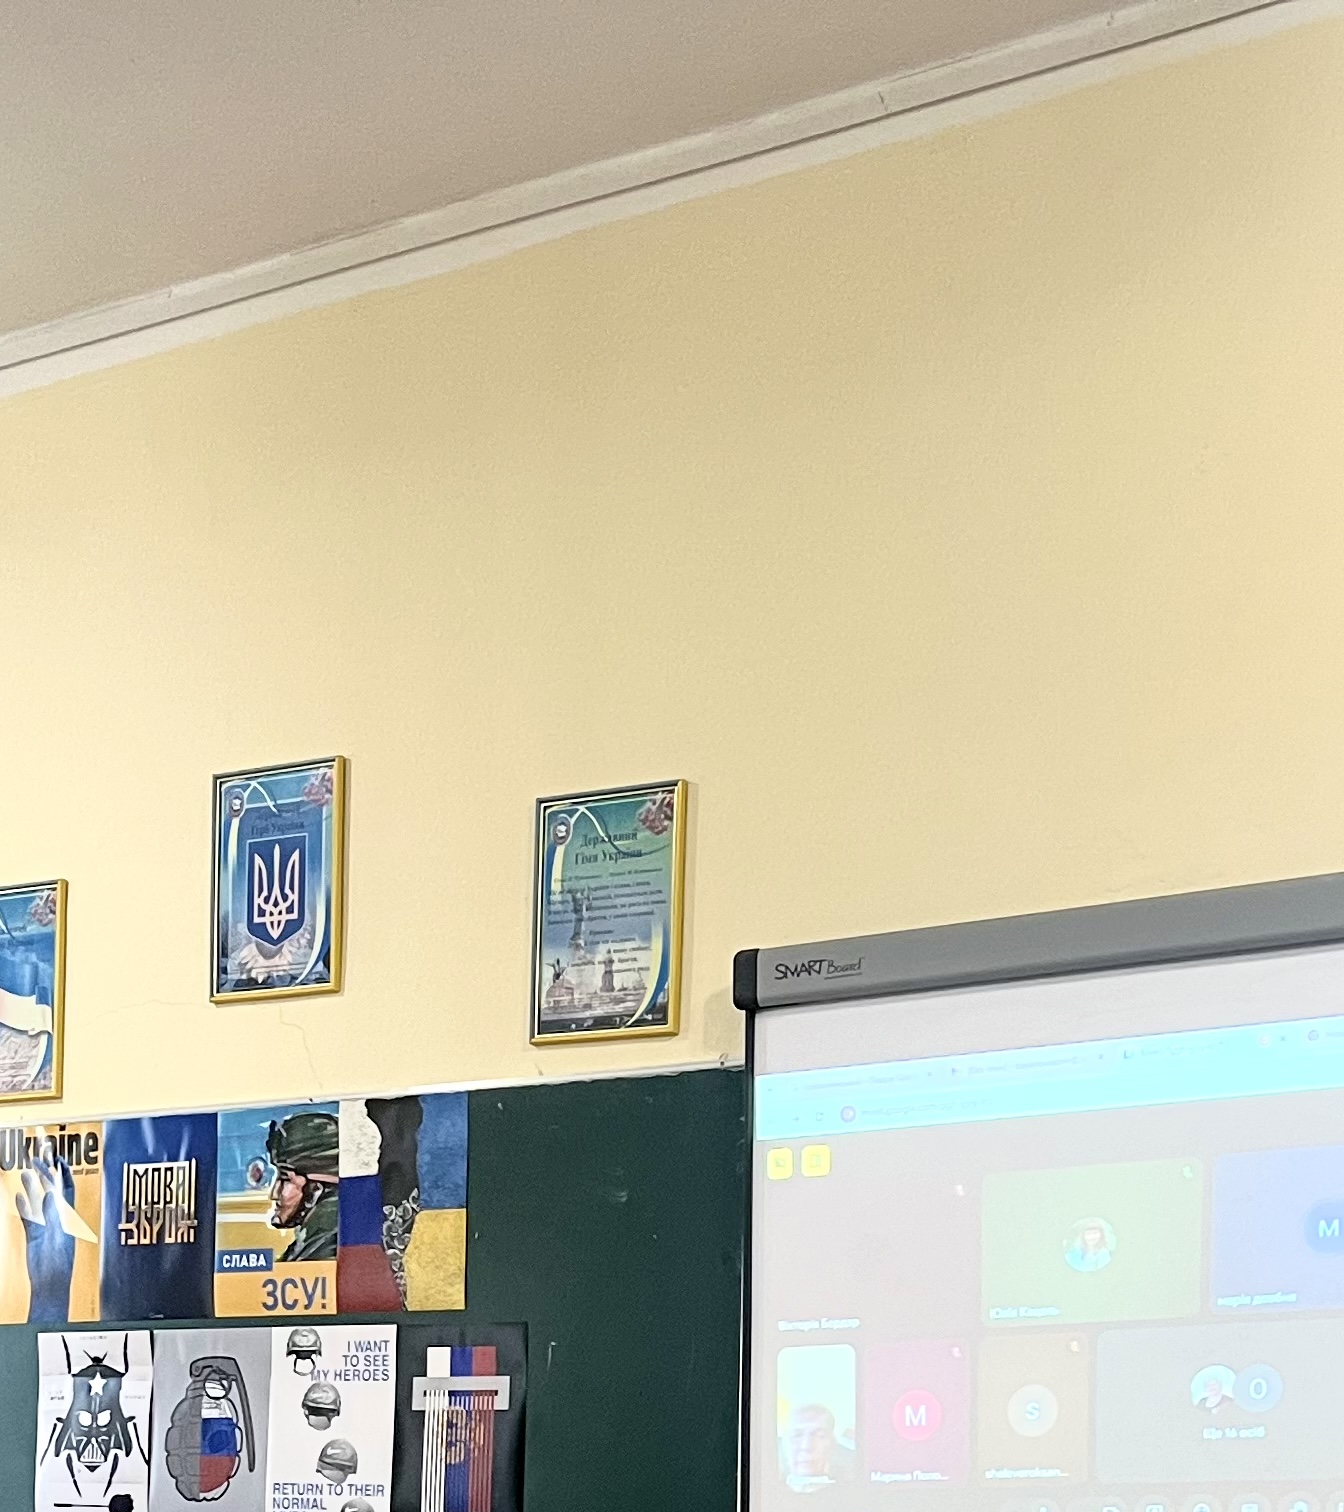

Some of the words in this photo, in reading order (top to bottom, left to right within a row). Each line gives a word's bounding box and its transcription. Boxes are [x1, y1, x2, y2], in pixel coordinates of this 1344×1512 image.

[774, 959, 828, 980] SMART
[0, 1123, 99, 1172] Ukraine
[222, 1253, 267, 1268] СЛАВА
[261, 1276, 327, 1311] ЗСУ!
[347, 1341, 351, 1353] I
[353, 1340, 390, 1353] WANT
[342, 1355, 360, 1368] TO
[363, 1355, 390, 1368] SEE
[310, 1369, 330, 1382] MY
[333, 1369, 390, 1382] HEROES
[273, 1483, 324, 1496] RETURN
[326, 1483, 344, 1496] TO
[346, 1483, 385, 1497] THEIR
[272, 1497, 327, 1511] NORMAL
